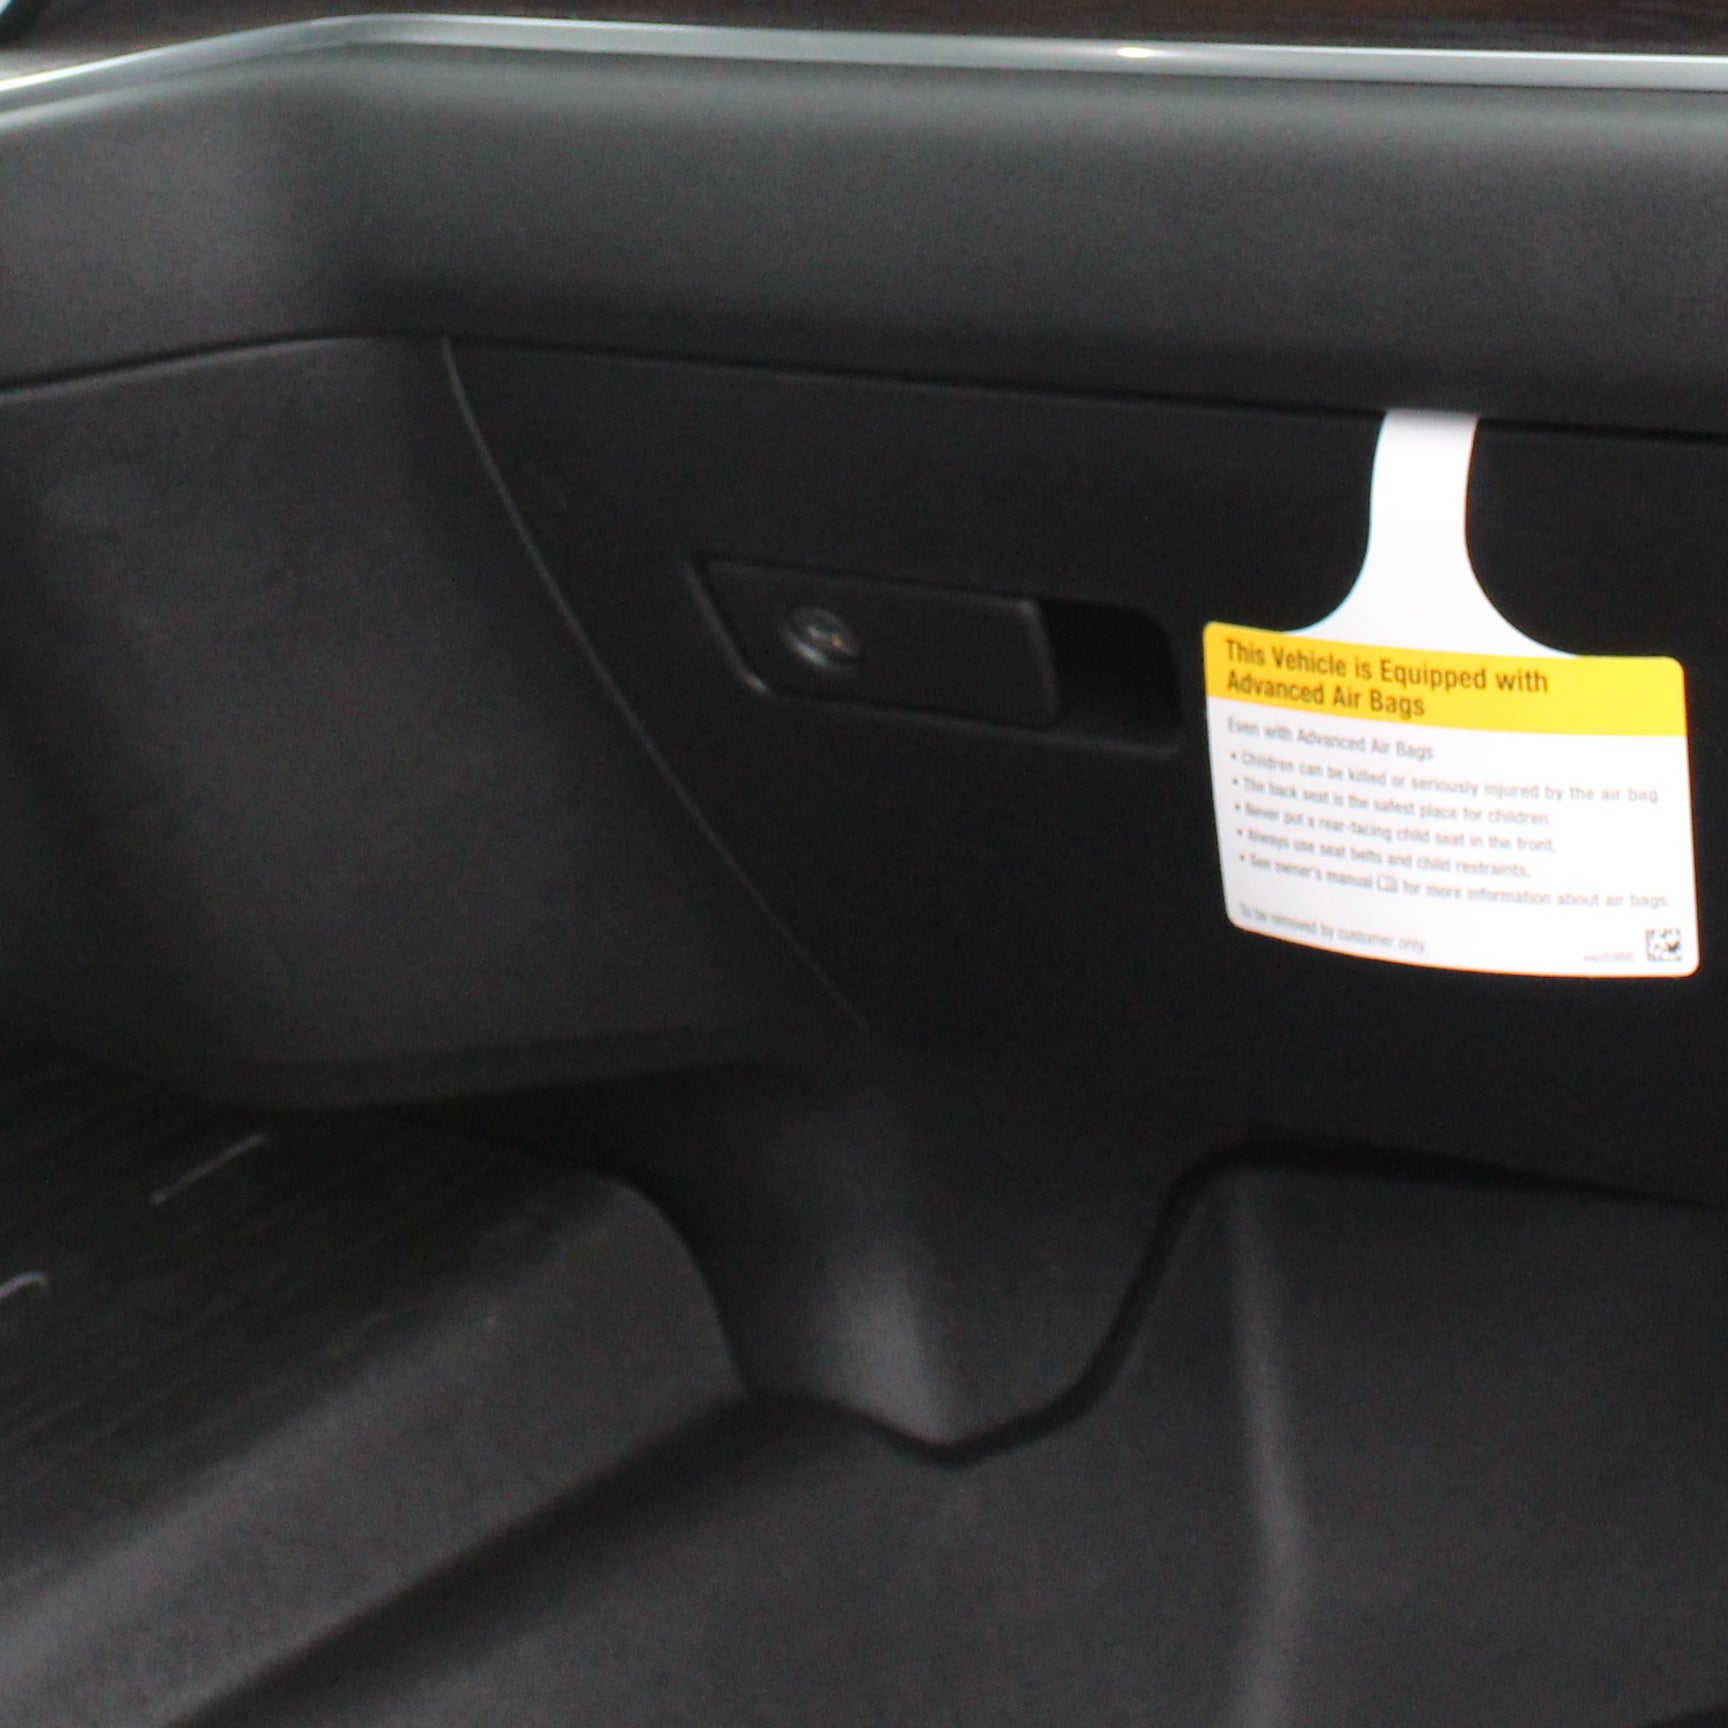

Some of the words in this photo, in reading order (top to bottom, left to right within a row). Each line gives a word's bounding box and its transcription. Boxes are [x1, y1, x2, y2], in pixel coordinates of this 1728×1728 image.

[1225, 637, 1265, 666] This
[1271, 646, 1346, 677] Vehicle
[1354, 656, 1372, 680] is
[1380, 658, 1486, 691] Equipped
[1495, 667, 1549, 693] with
[1227, 669, 1324, 705] Advanced
[1332, 684, 1361, 708] Air
[1369, 688, 1425, 720] Bags
[1227, 715, 1260, 736] Even
[1263, 725, 1293, 741] with
[1296, 728, 1366, 752] Advanced
[1371, 738, 1390, 754] Air
[1395, 740, 1434, 763] Bags
[1240, 749, 1294, 772] Children
[1298, 763, 1323, 776] can
[1327, 764, 1343, 780] be
[1348, 768, 1386, 786] killed
[1391, 775, 1405, 788] or
[1411, 778, 1479, 798] seriously
[1484, 781, 1539, 799] injured
[1544, 785, 1563, 803] by
[1570, 786, 1594, 801] the
[1601, 788, 1621, 802] air
[1628, 787, 1663, 805] bag.
[1243, 776, 1265, 793] The
[1268, 781, 1297, 798] back
[1302, 790, 1329, 804] seat
[1333, 793, 1344, 806] is
[1348, 795, 1369, 810] the
[1373, 799, 1415, 815] safest
[1420, 804, 1457, 819] place
[1463, 805, 1482, 821] for
[1488, 809, 1553, 825] children.
[1244, 802, 1280, 820] Never
[1282, 813, 1304, 827] put
[1318, 818, 1393, 843] rear-facing
[1396, 828, 1430, 843] child
[1435, 833, 1464, 847] seat
[1470, 834, 1483, 848] in
[1488, 835, 1511, 850] the
[1517, 837, 1556, 853] front.
[1247, 828, 1290, 850] Always
[1293, 839, 1315, 853] use
[1319, 844, 1346, 858] seat
[1350, 847, 1382, 864] belts
[1387, 854, 1412, 868] and
[1416, 856, 1451, 872] child
[1456, 861, 1530, 877] restraints.
[1325, 871, 1373, 889] manual
[1402, 879, 1420, 895] for
[1425, 884, 1462, 900] more
[1467, 887, 1551, 905] information
[1558, 892, 1599, 907] about
[1605, 893, 1624, 907] air
[1630, 892, 1669, 910] bags.
[1337, 928, 1394, 946] customer
